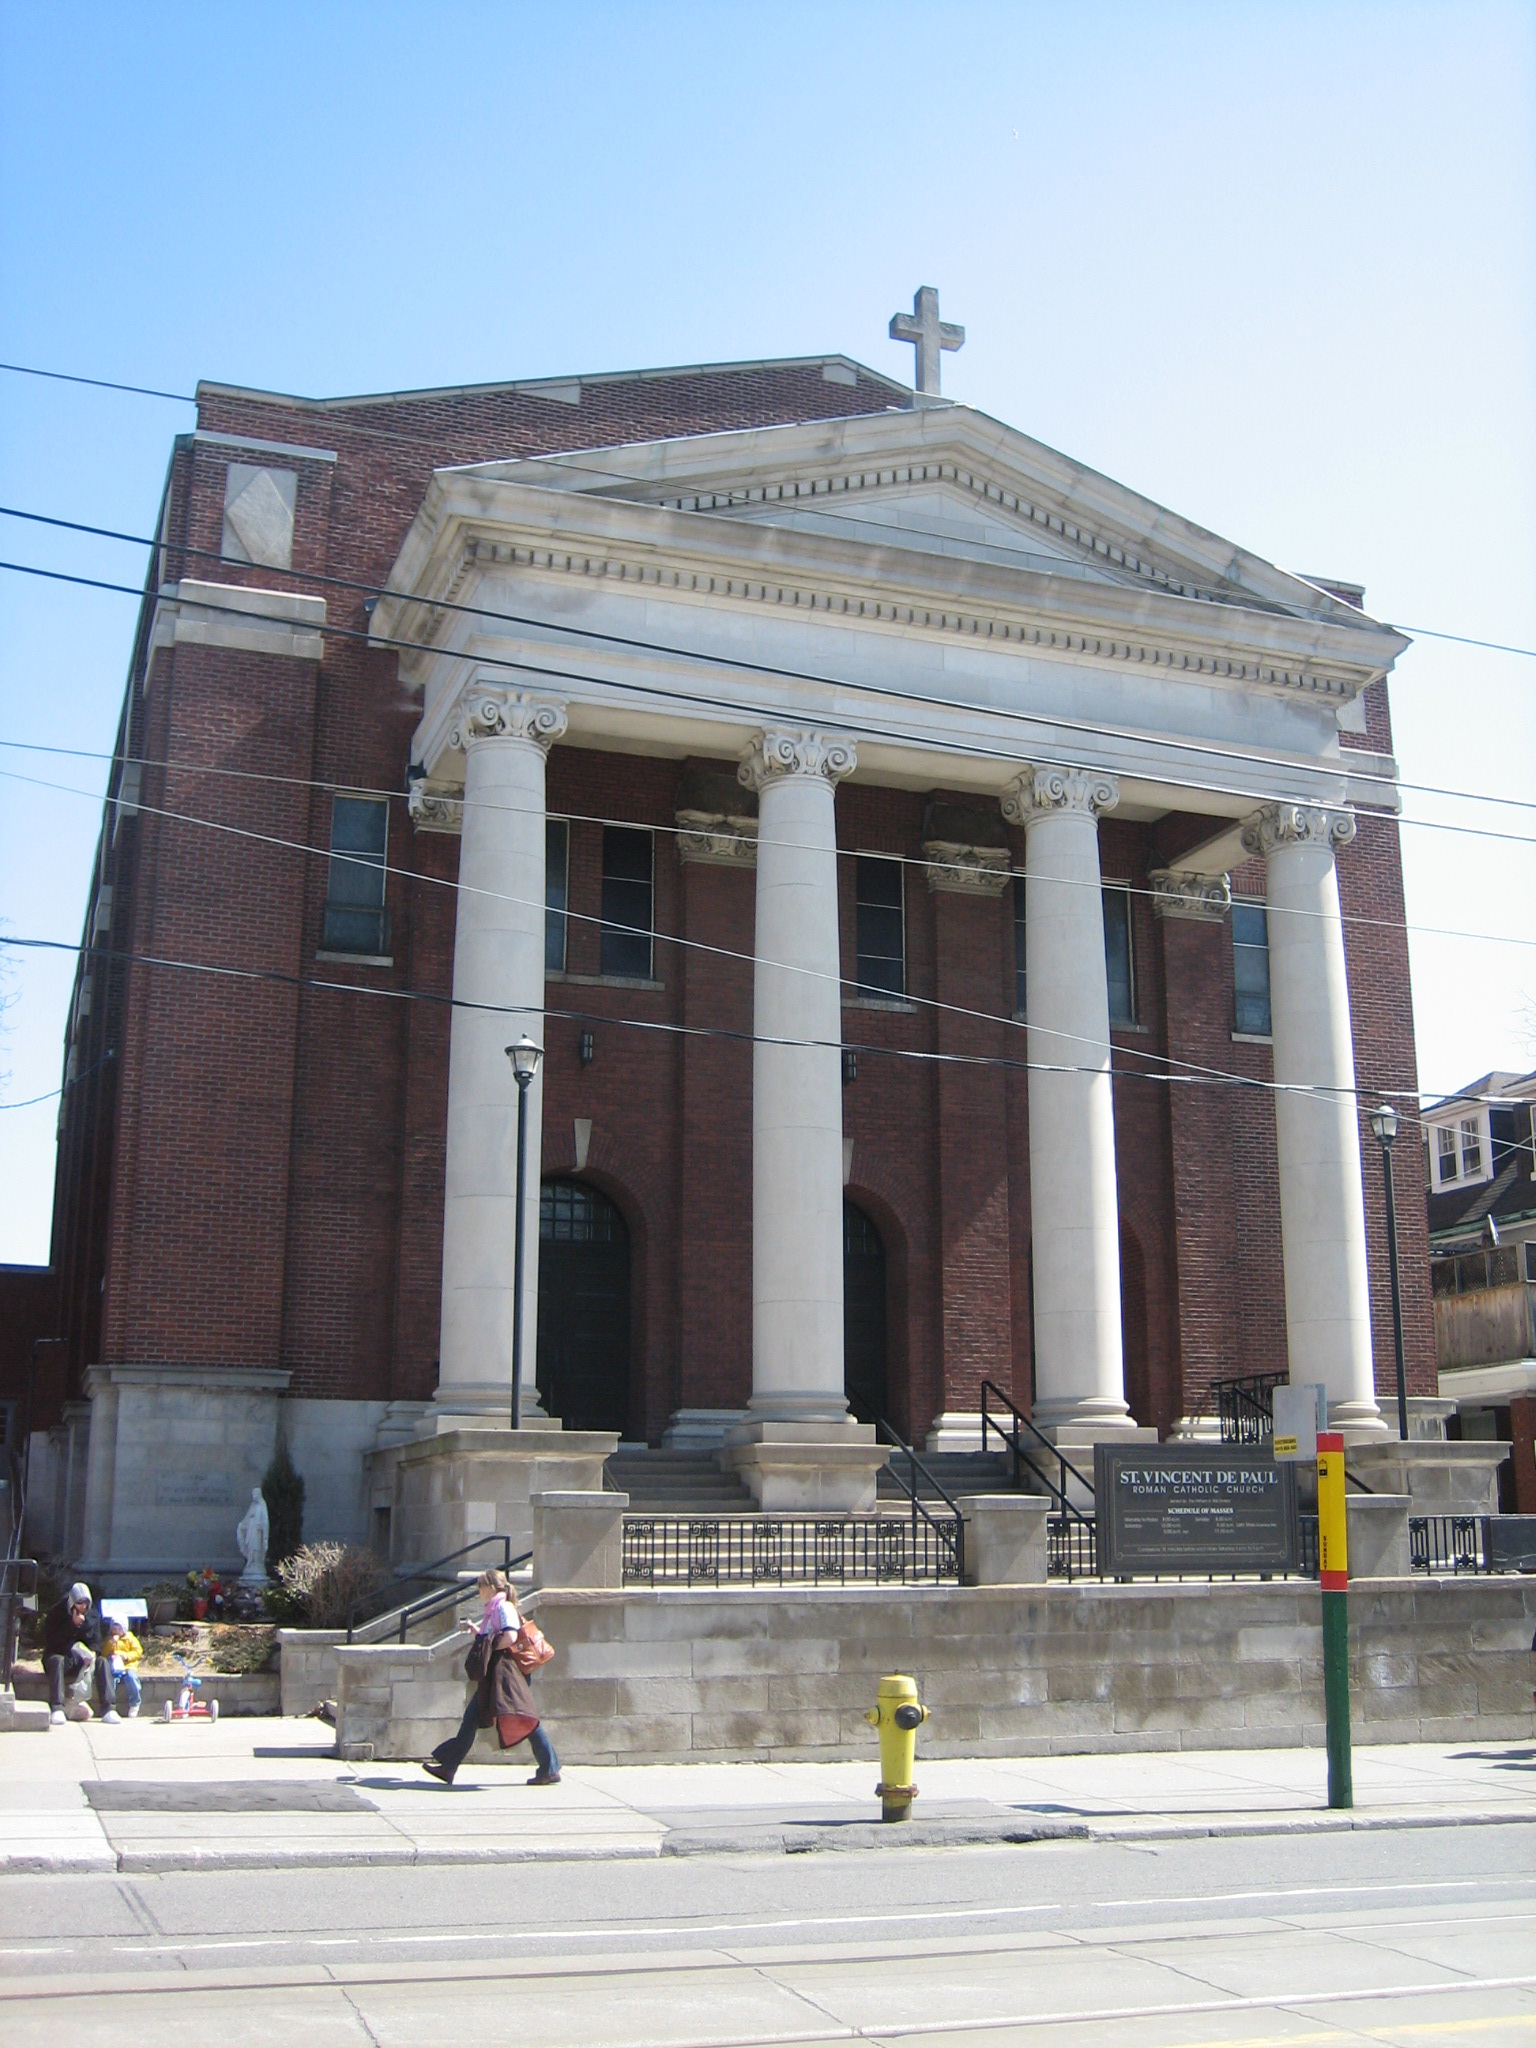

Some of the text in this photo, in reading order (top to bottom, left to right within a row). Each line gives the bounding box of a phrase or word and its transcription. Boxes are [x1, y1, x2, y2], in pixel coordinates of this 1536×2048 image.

[1120, 1470, 1278, 1484] ST. VINCENT DE PAUL
[1133, 1485, 1264, 1494] ROMAN CATHOLIC CHURCH
[1167, 1507, 1200, 1515] SCHEDULE
